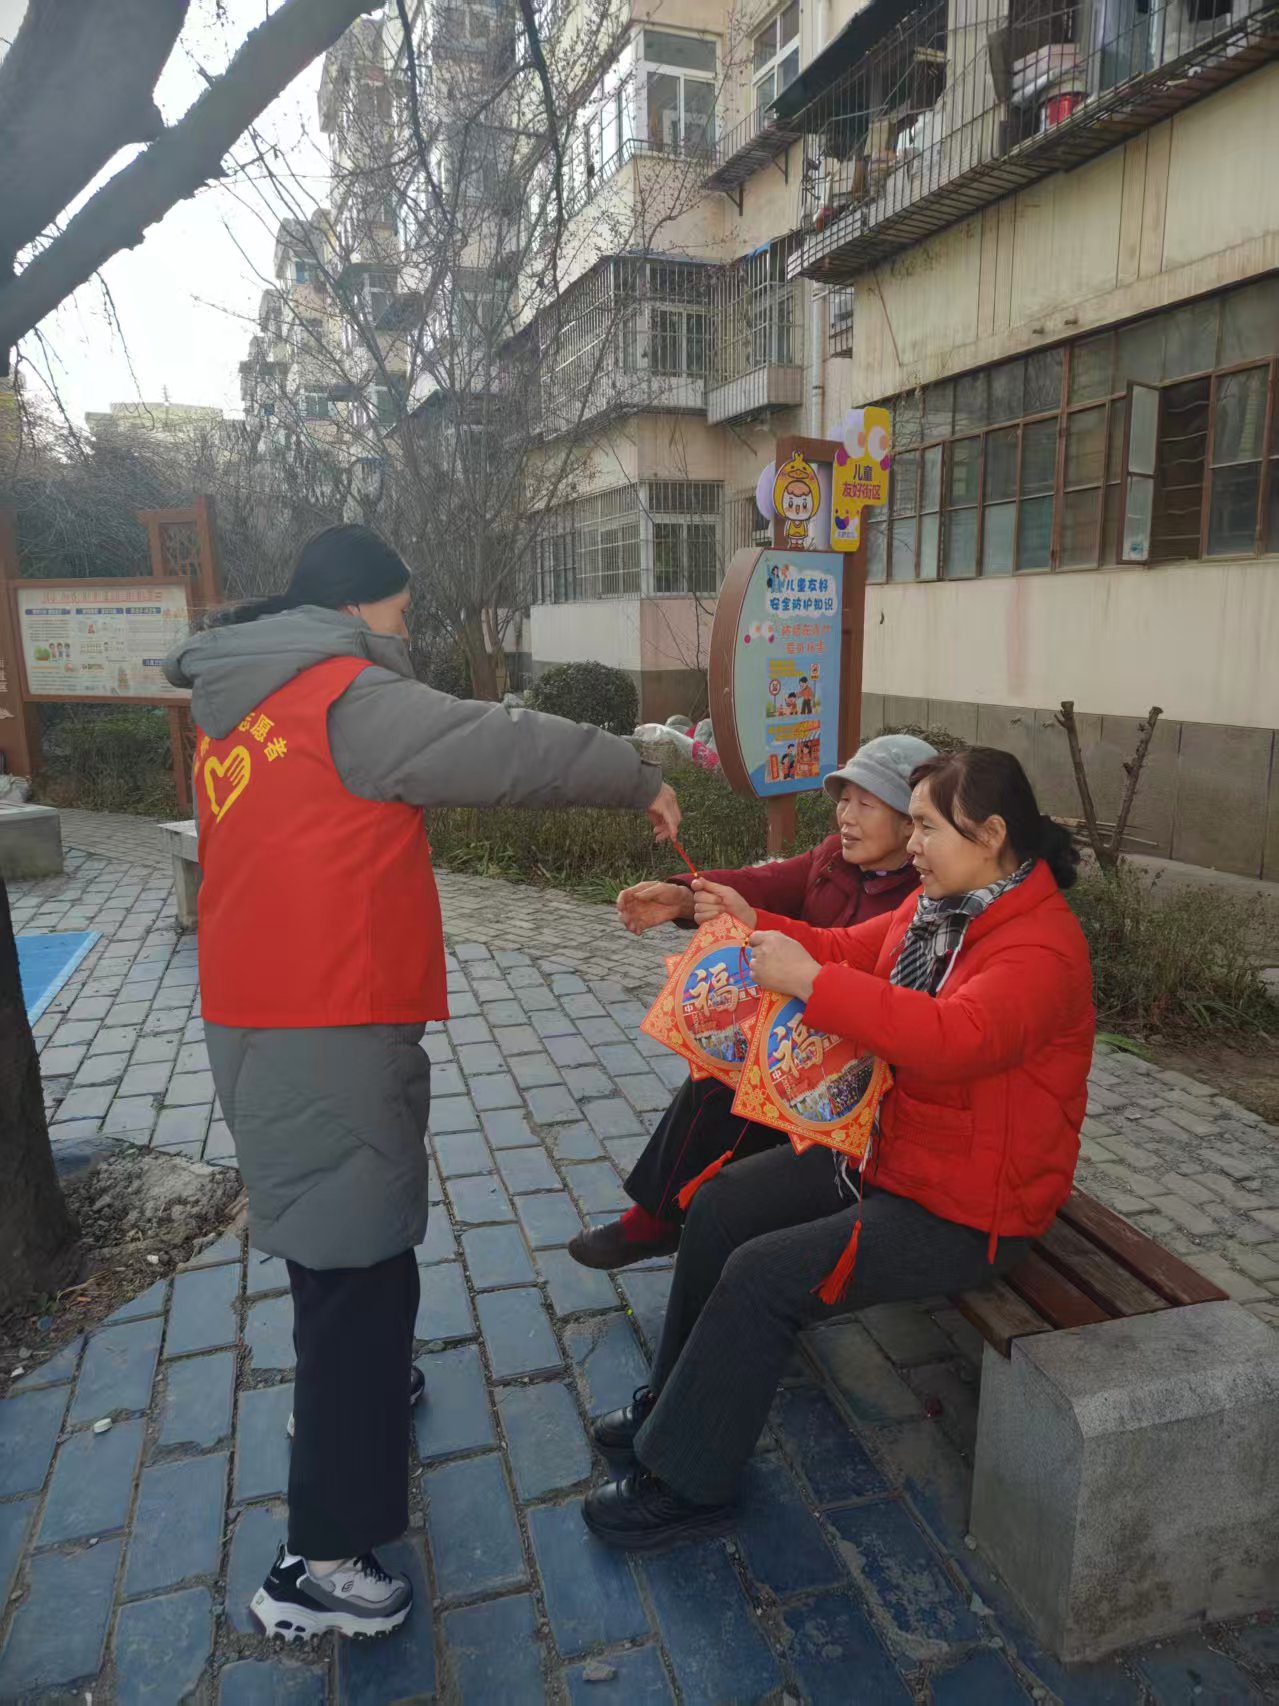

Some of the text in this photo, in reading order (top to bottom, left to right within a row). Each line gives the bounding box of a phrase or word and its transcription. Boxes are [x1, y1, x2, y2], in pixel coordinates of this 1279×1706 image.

[853, 463, 873, 481] 儿童
[842, 482, 881, 500] 友好街区
[786, 577, 828, 593] 儿童友好
[769, 597, 833, 611] 安全防护知识
[689, 962, 739, 1017] 福
